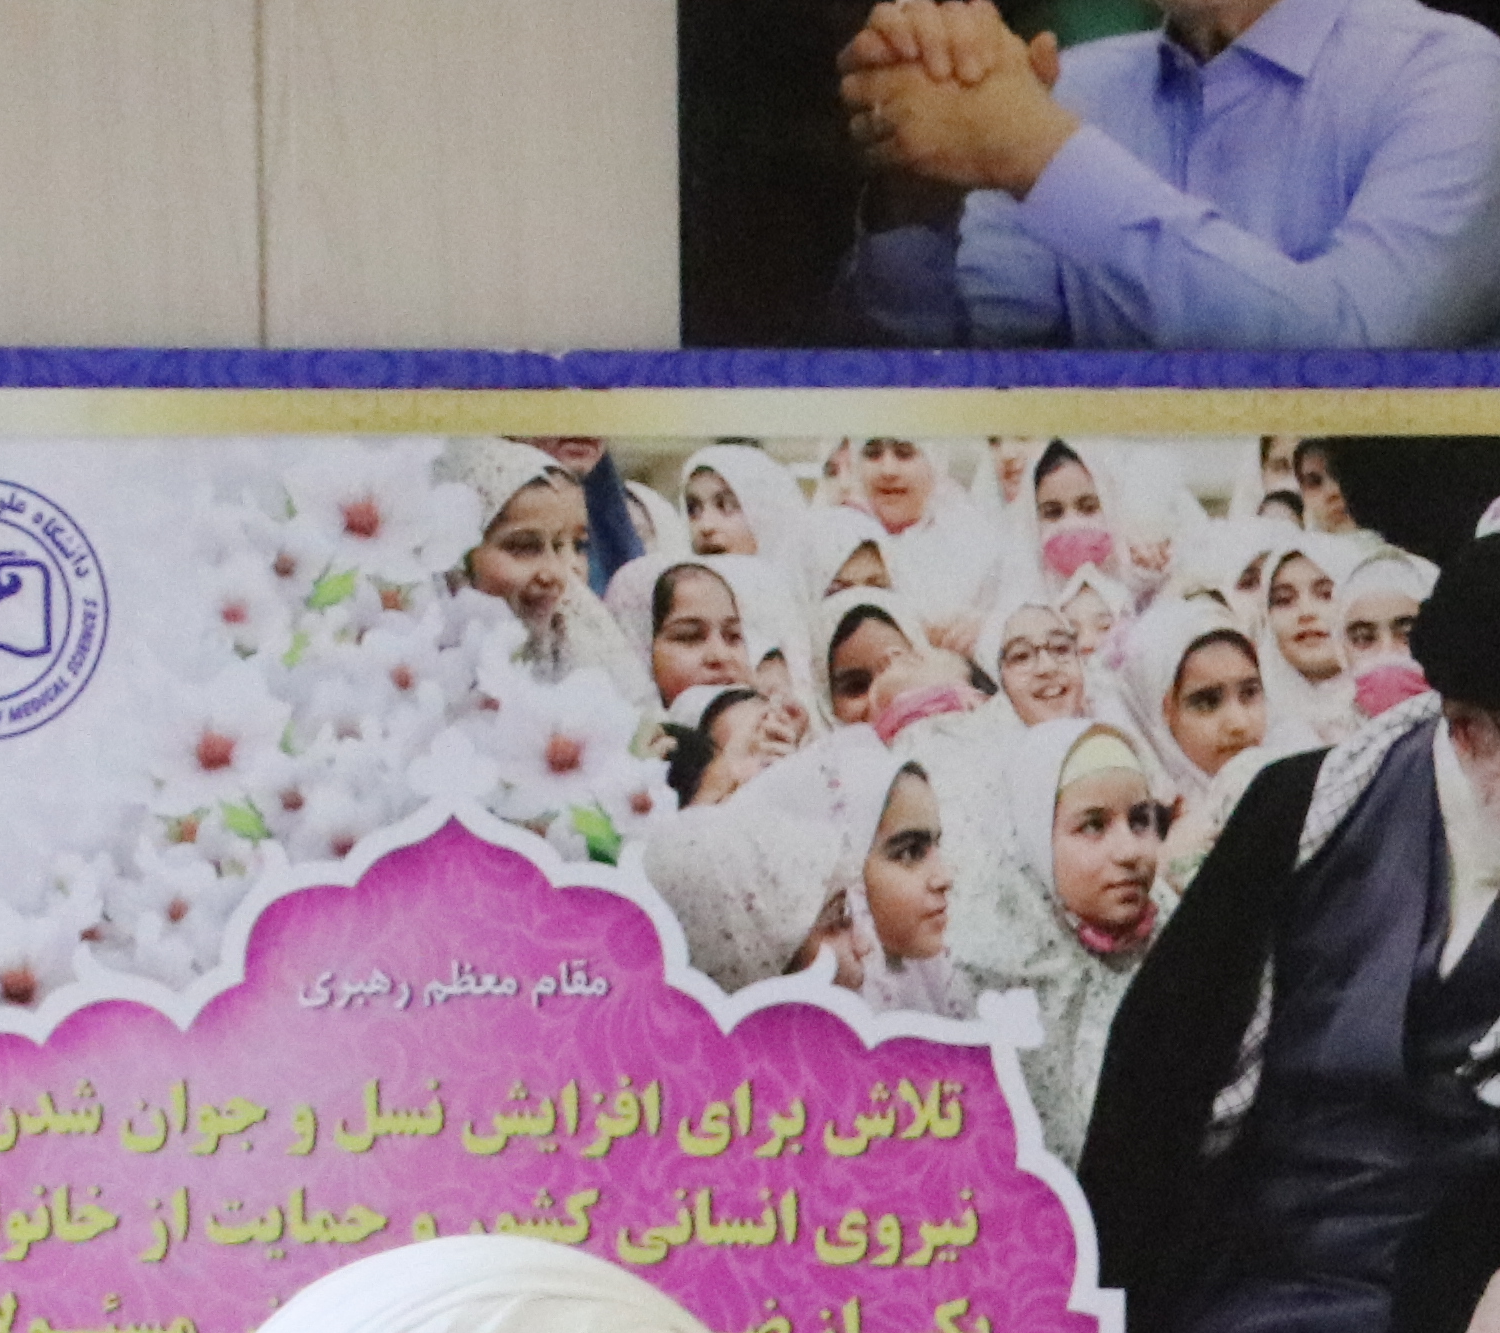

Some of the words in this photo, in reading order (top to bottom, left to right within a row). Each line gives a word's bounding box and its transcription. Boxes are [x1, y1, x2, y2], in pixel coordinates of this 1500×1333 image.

[8, 675, 70, 723] MEDICAL
[299, 967, 414, 1012] رهبری
[422, 959, 520, 1007] معظم
[532, 959, 612, 1008] مقام
[119, 1079, 269, 1156] جوان
[286, 1103, 317, 1156] و
[334, 1078, 447, 1153] نسل
[461, 1075, 661, 1158] افزایش
[677, 1079, 807, 1159] برای
[822, 1078, 964, 1158] تلاش
[139, 1186, 190, 1263] از
[205, 1186, 389, 1261] حمایت
[617, 1187, 799, 1266] انسانی
[814, 1188, 980, 1268] نیروی
